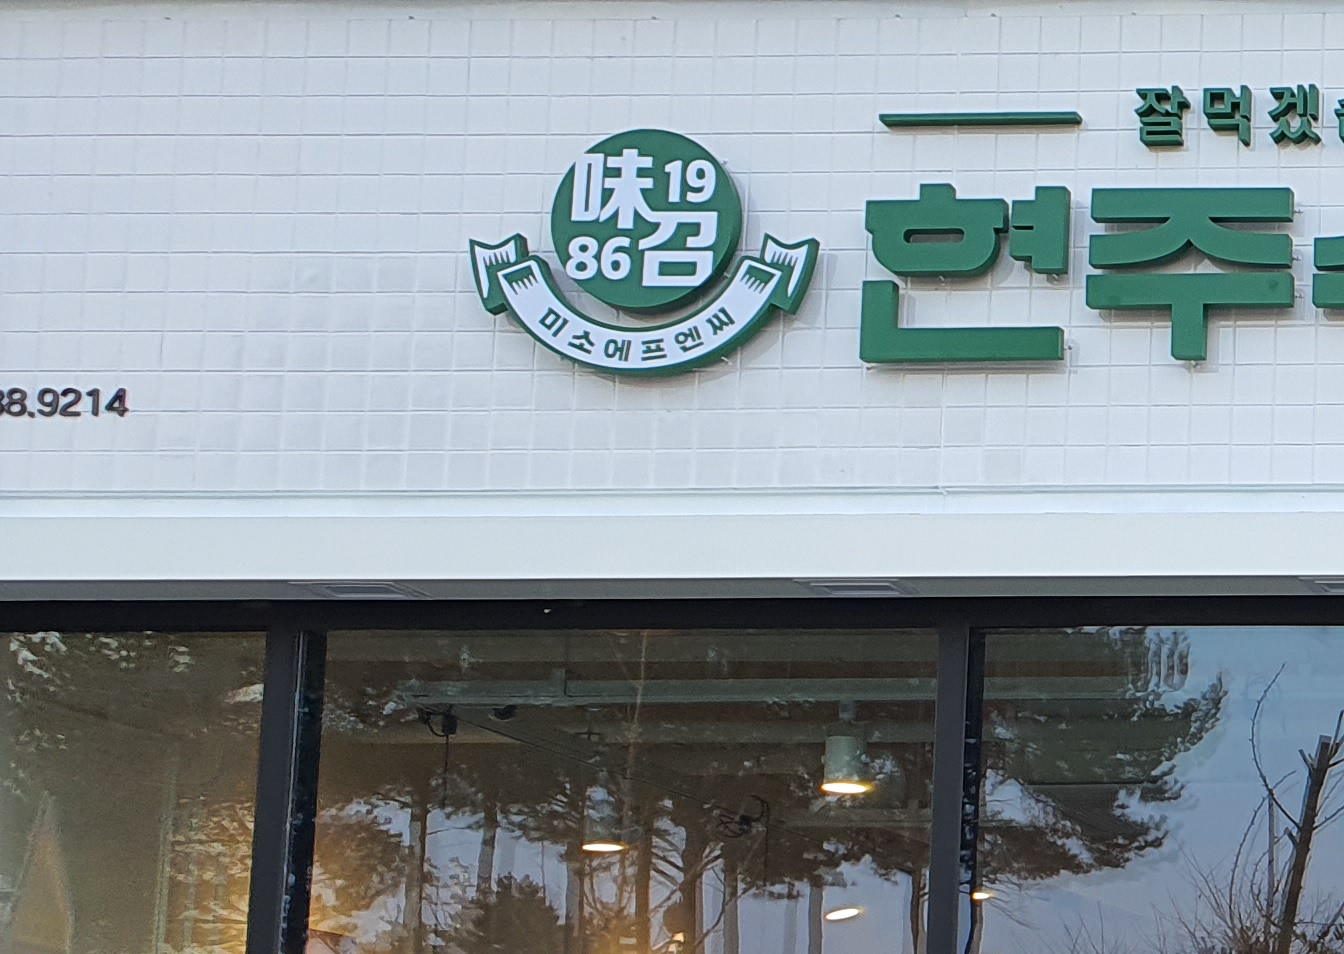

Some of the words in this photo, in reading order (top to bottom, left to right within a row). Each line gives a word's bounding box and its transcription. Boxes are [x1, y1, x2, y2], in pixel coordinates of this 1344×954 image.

[664, 159, 716, 204] 19
[565, 237, 632, 281] 86
[537, 305, 737, 363] 미소에프엔씨
[0, 387, 130, 418] 8.9214
